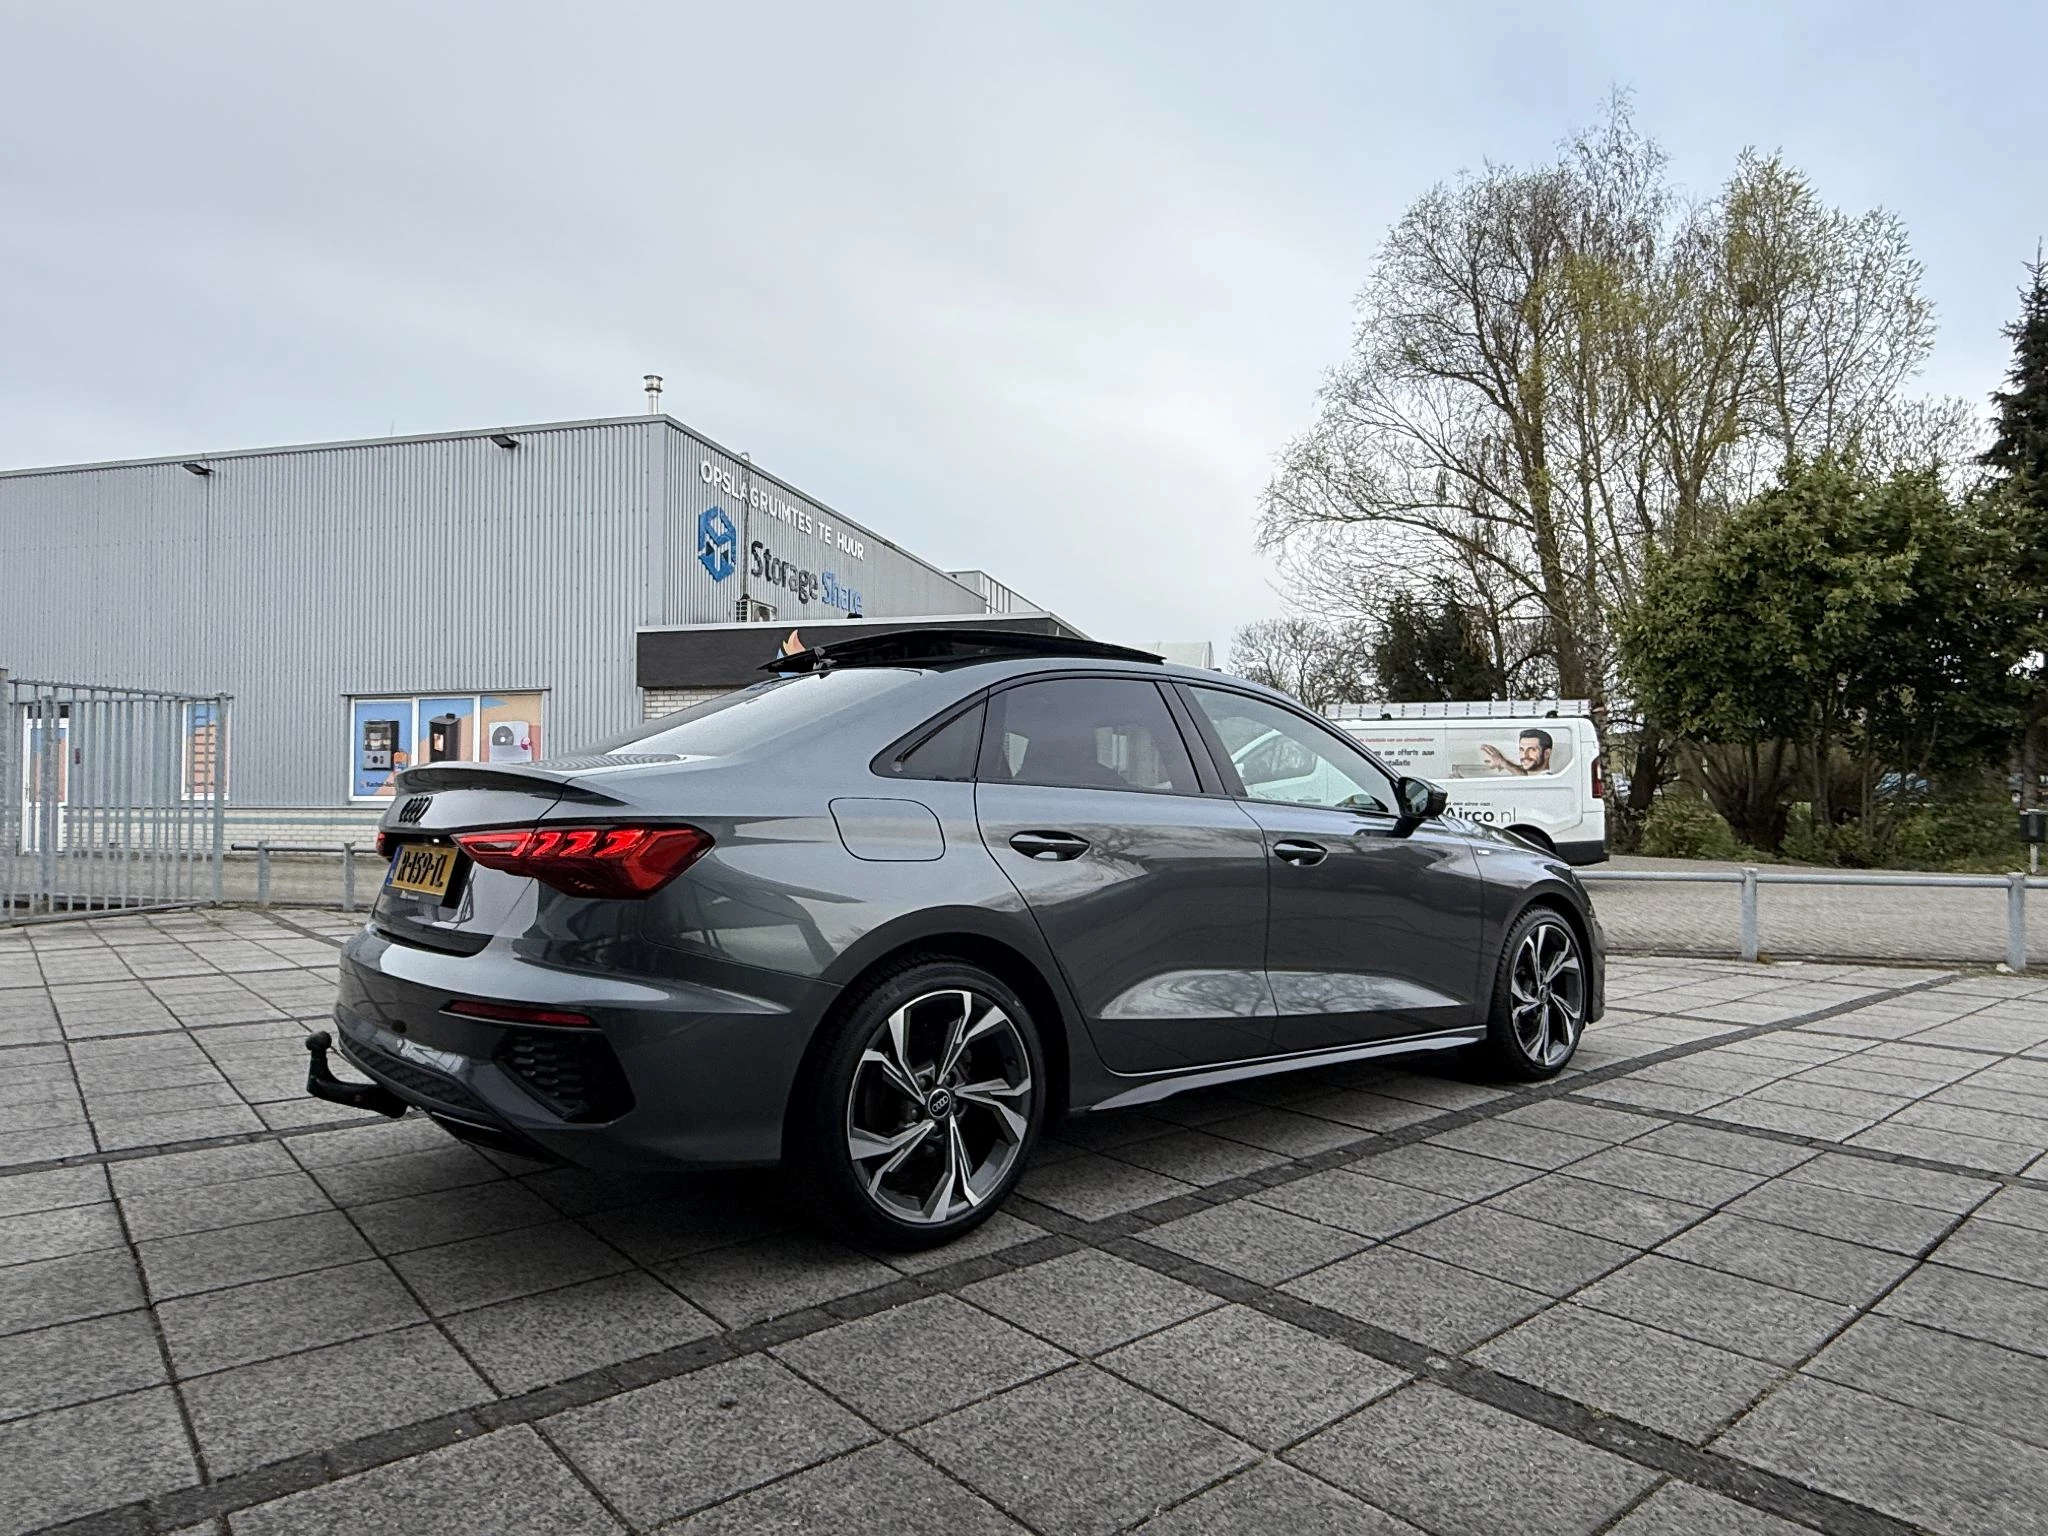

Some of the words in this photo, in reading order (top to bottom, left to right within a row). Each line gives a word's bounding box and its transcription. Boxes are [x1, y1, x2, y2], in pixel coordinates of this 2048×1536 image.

[700, 461, 812, 535] OPSLAGRUIMTES
[818, 522, 831, 544] TE
[838, 532, 864, 560] HUUR
[751, 540, 818, 605] Storage
